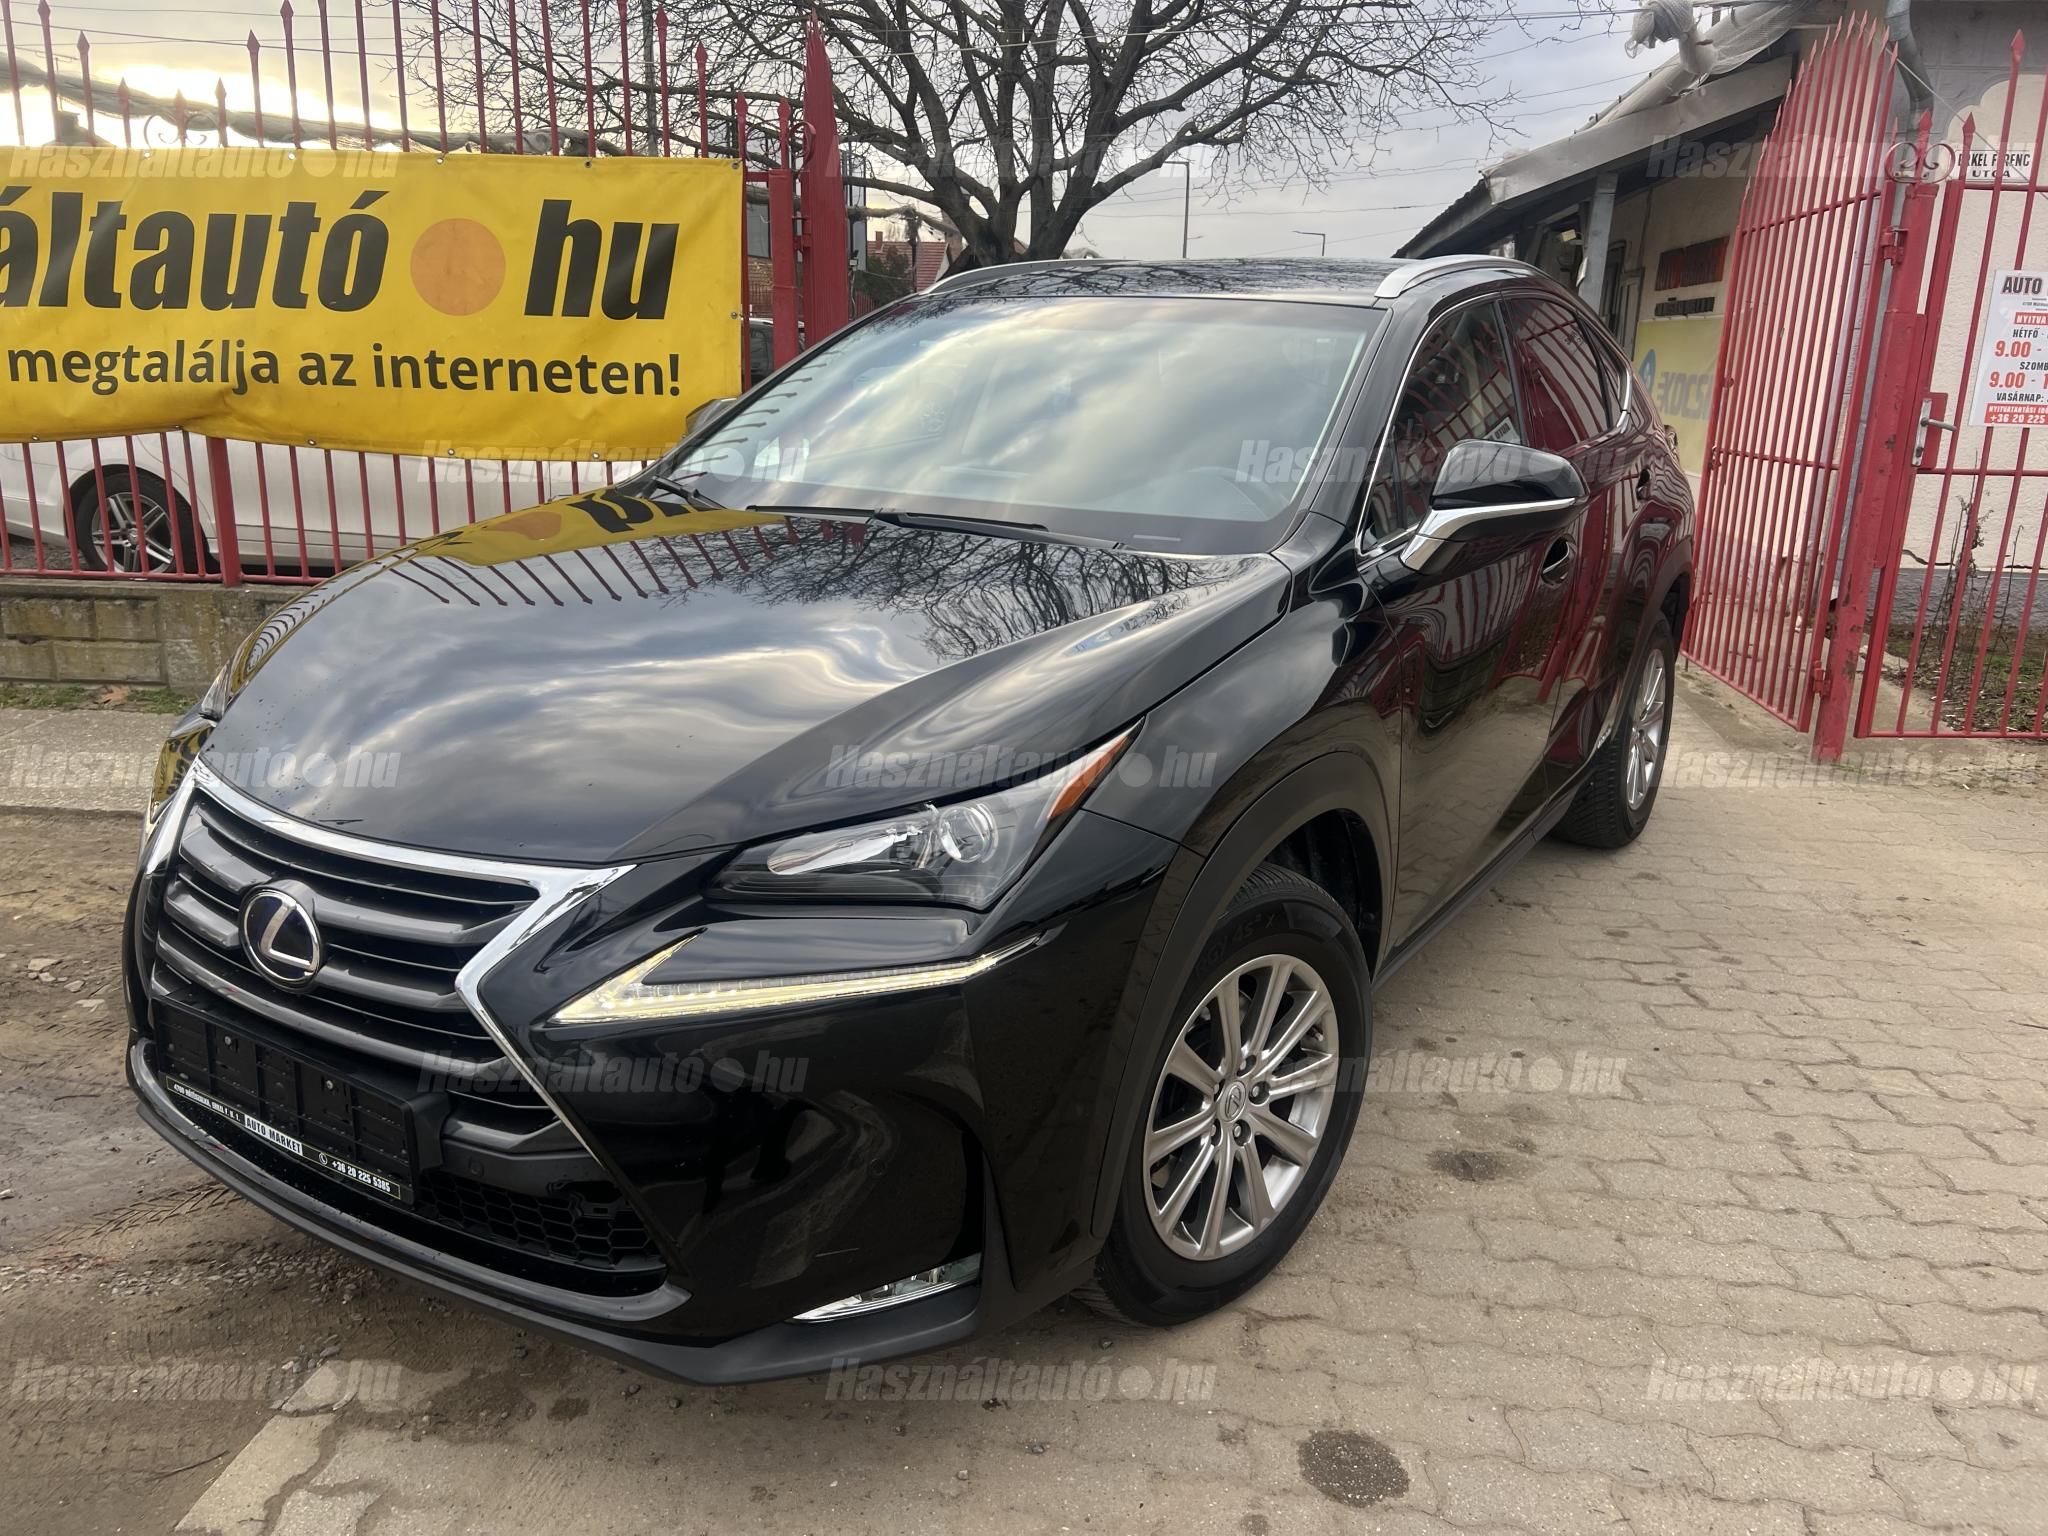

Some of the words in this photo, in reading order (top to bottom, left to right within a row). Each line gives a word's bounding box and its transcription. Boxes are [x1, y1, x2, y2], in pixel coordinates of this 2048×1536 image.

[1992, 153, 2031, 166] FRENC
[524, 199, 680, 321] hu
[2001, 276, 2043, 295] AUTO
[2012, 326, 2040, 339] HÉTFŐ
[1994, 340, 2032, 357] 9.00
[9, 339, 280, 396] megtalálja
[298, 351, 358, 389] az
[374, 342, 681, 397] interneten!
[1989, 371, 2026, 388] 9.00
[1996, 391, 2045, 403] VASÁRNAP:
[1990, 413, 2010, 423] +36
[2011, 413, 2025, 423] 20
[2026, 415, 2046, 424] 225
[246, 1116, 267, 1136] AUTO
[269, 1128, 301, 1154] MARKET
[332, 1160, 347, 1173] +36
[347, 1165, 357, 1178] 20
[357, 1170, 372, 1184] 225
[372, 1176, 391, 1193] 5385
